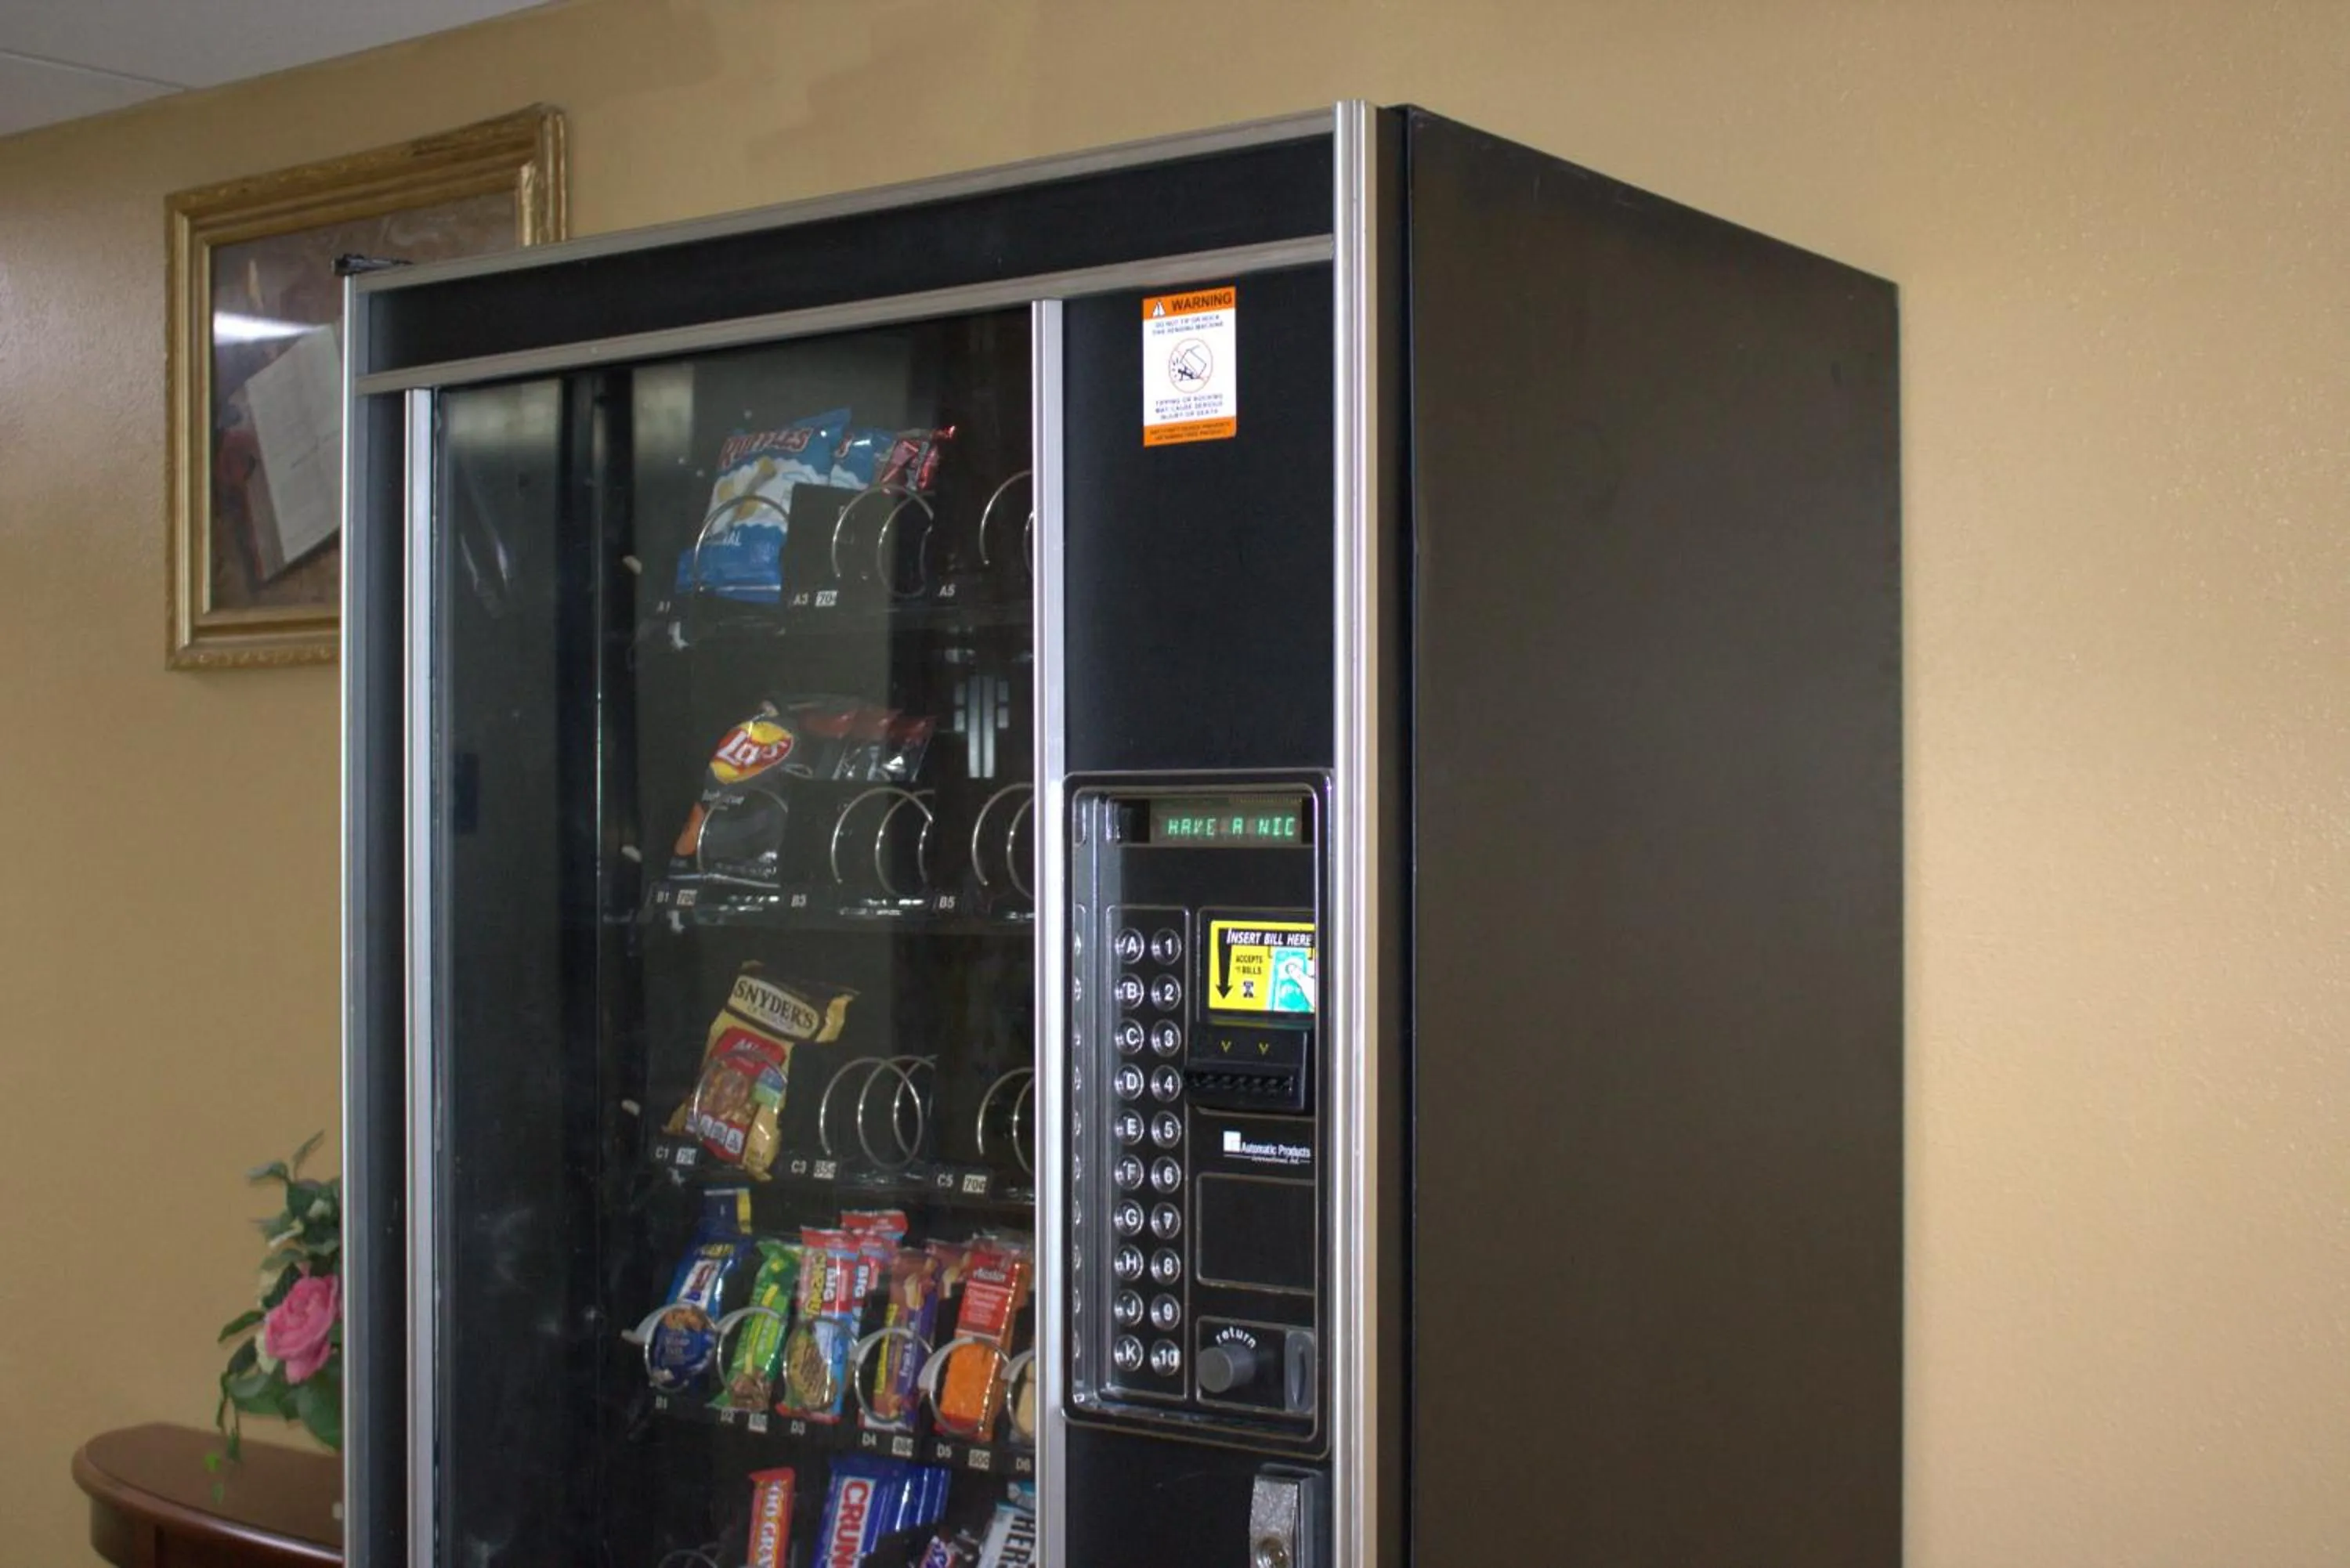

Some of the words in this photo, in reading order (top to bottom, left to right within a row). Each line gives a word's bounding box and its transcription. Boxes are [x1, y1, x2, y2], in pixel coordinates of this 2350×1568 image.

[1171, 291, 1233, 311] WARNING
[1167, 818, 1217, 836] HAVE
[1231, 817, 1244, 836] A
[1257, 817, 1296, 836] NIC
[1126, 936, 1137, 954] A
[1164, 938, 1173, 956] 1
[1226, 927, 1262, 945] INSERT
[1264, 931, 1284, 945] BILL
[1286, 932, 1312, 946] HERE
[1235, 955, 1264, 964] ACCEPTS
[1126, 981, 1137, 999] B
[1163, 983, 1174, 1001] 2
[733, 980, 815, 1030] SNYDER'S
[1126, 1027, 1137, 1046] C
[1164, 1029, 1174, 1047] 3
[1126, 1072, 1137, 1090] D
[1163, 1075, 1173, 1093] 4
[1126, 1118, 1137, 1136] E
[1164, 1121, 1173, 1139] 5
[1241, 1141, 1277, 1156] Automatic
[1278, 1144, 1311, 1158] Products
[1127, 1163, 1137, 1180] F
[1163, 1166, 1173, 1184] 6
[1125, 1209, 1137, 1227] G
[1163, 1212, 1173, 1230] 7
[1126, 1254, 1137, 1271] H
[1163, 1257, 1173, 1275] 8
[855, 1264, 870, 1299] BIG
[1126, 1299, 1136, 1317] J
[1163, 1302, 1173, 1321] 9
[1214, 1326, 1257, 1349] return
[1125, 1343, 1137, 1361] K
[1160, 1348, 1179, 1365] 10
[830, 1479, 869, 1568] CRUN
[998, 1516, 1036, 1568] HER
